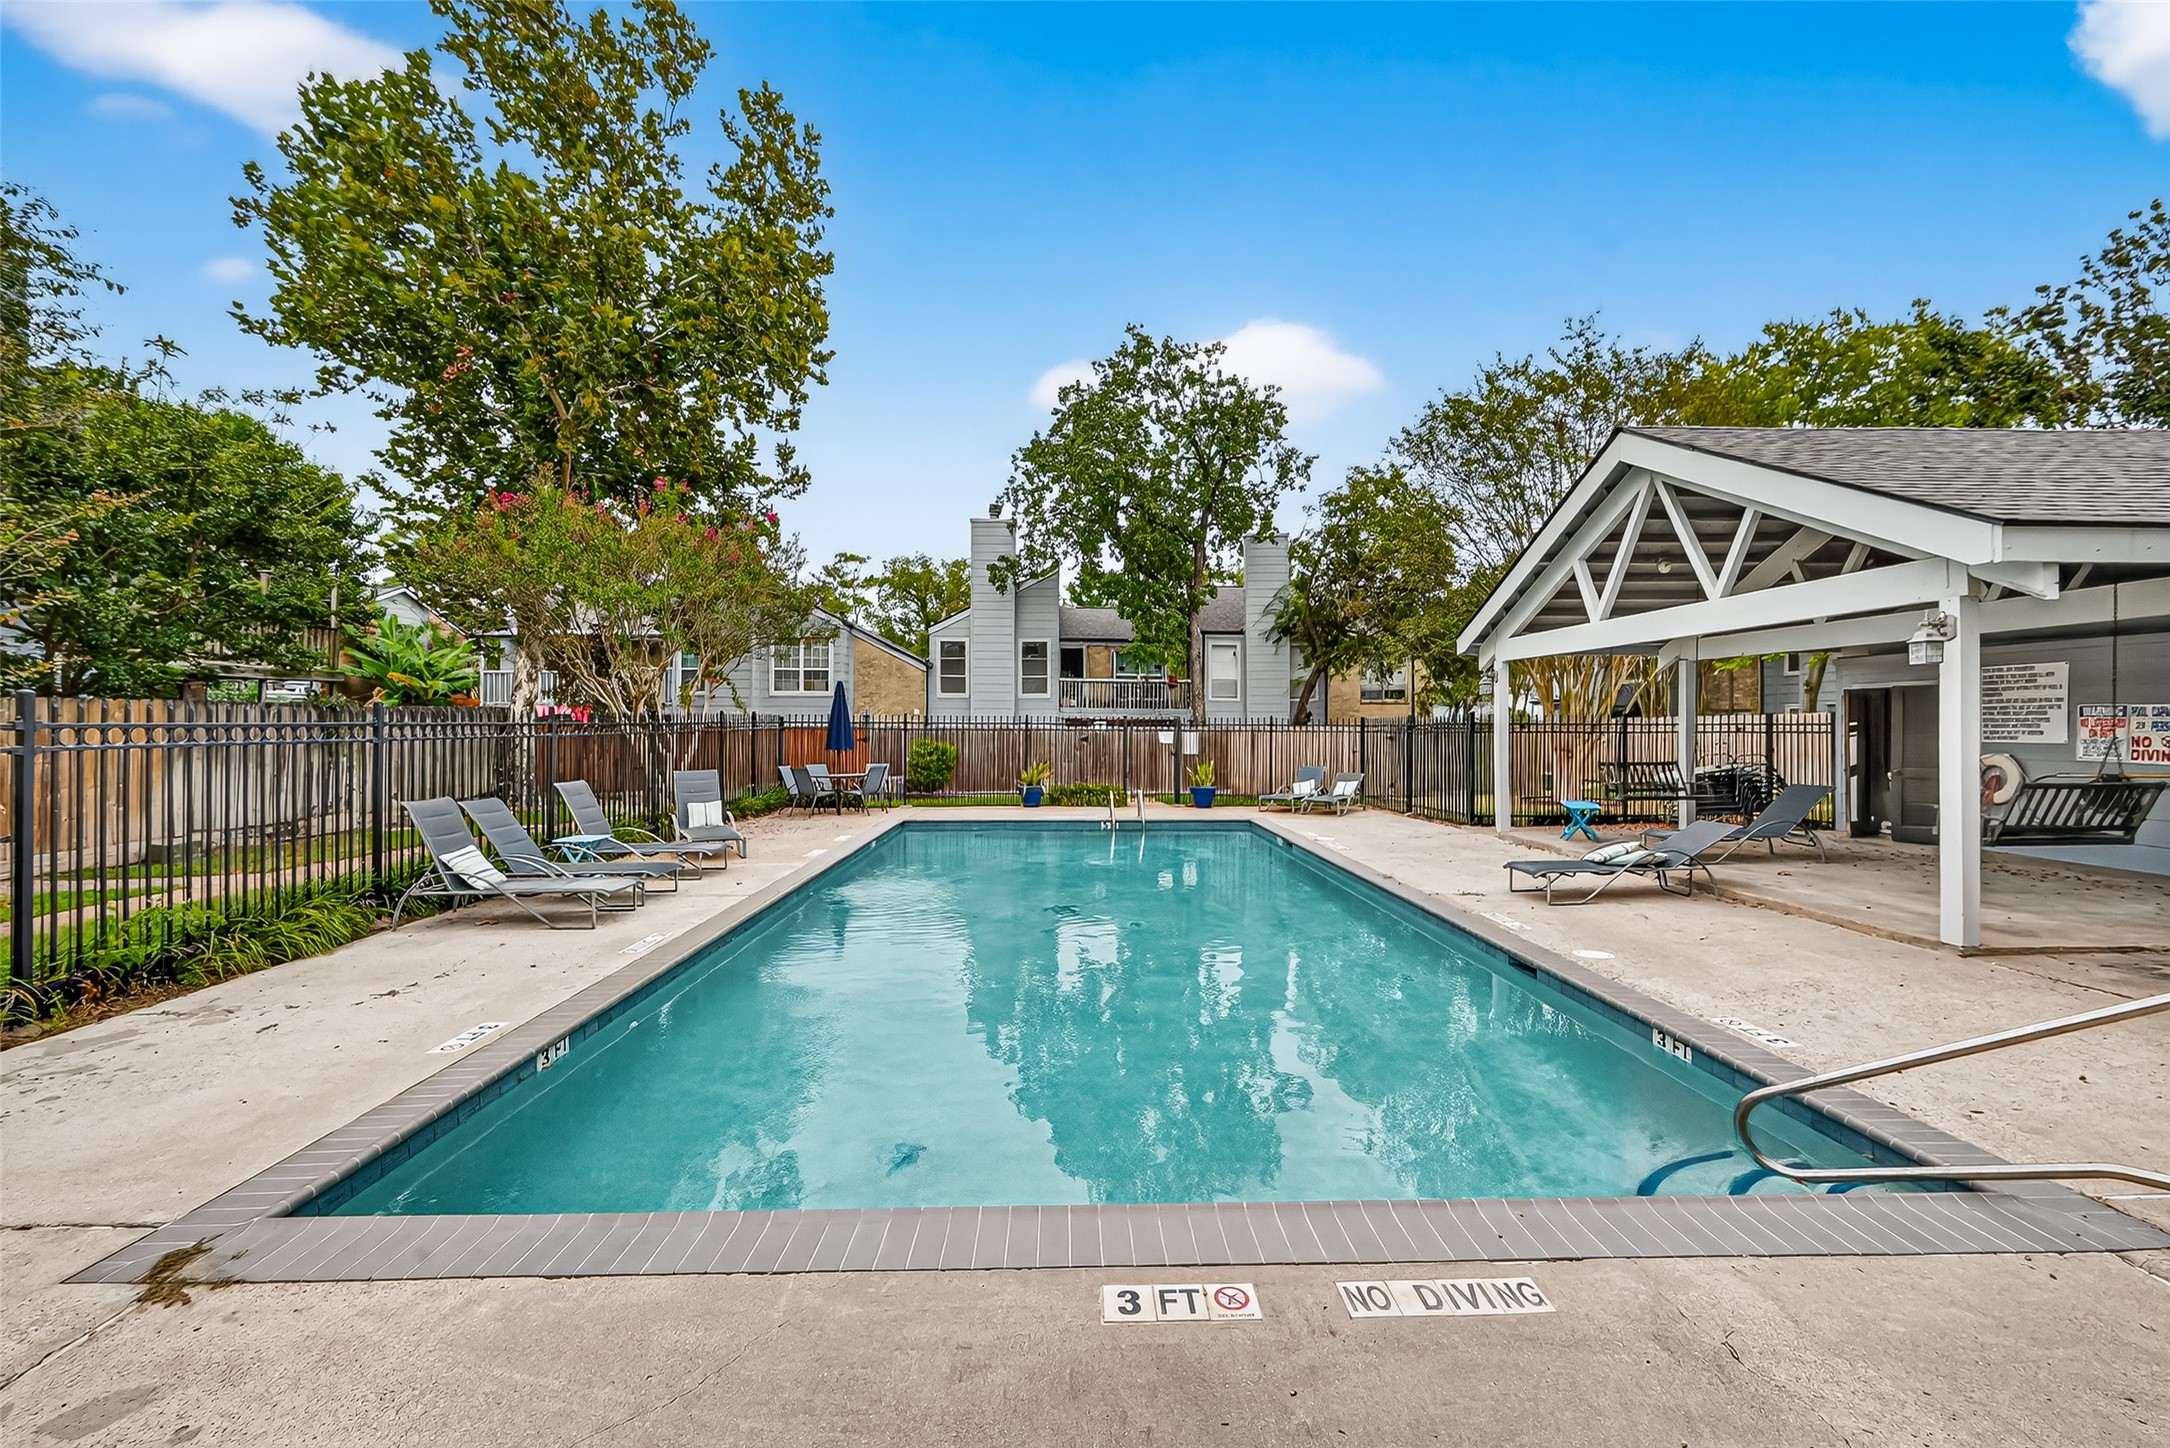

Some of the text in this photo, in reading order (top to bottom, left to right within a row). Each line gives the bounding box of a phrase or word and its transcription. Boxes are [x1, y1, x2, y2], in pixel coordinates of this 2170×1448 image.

[2131, 735, 2153, 748] NO
[541, 1049, 550, 1066] 3
[1117, 1289, 1200, 1315] 3 FT
[1342, 1282, 1548, 1312] NO DIVING
